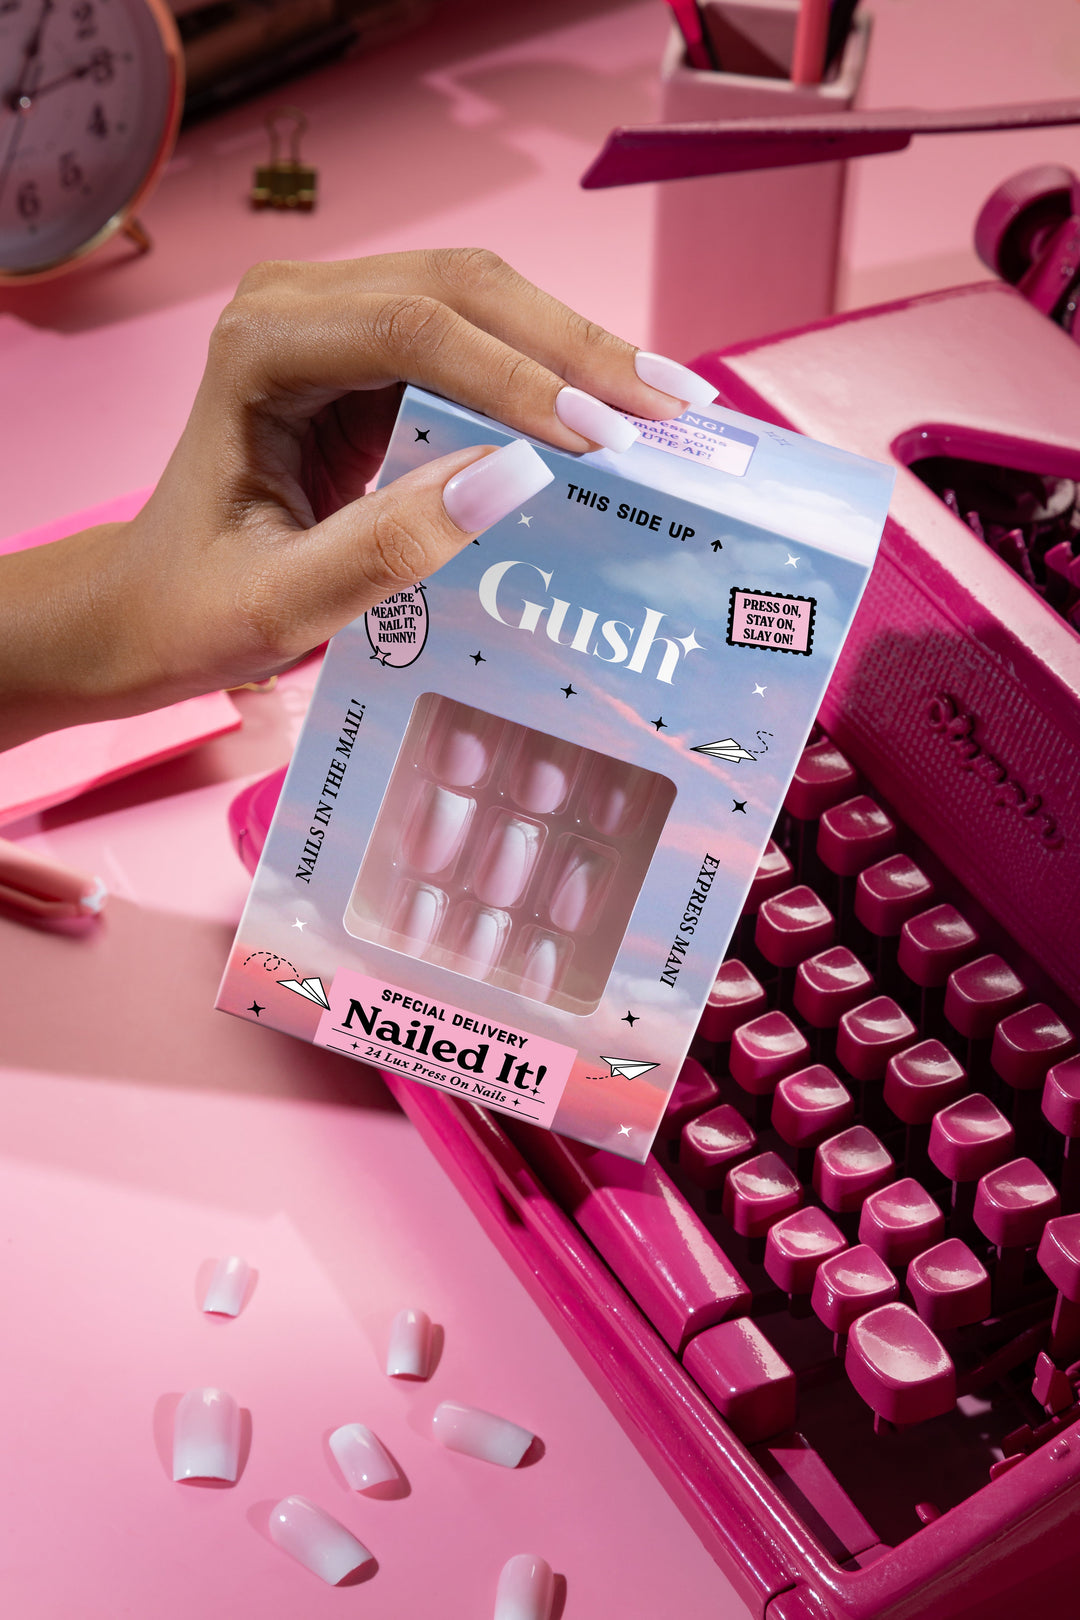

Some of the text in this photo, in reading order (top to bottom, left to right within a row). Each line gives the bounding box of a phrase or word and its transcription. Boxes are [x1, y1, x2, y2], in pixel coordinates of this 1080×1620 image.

[86, 101, 110, 141] 4
[59, 150, 83, 190] 5
[16, 179, 42, 220] 6
[633, 421, 716, 451] make you
[641, 432, 712, 460] UTE AF!
[651, 419, 728, 447] ress Ons
[567, 483, 695, 542] THIS SIDE UP
[371, 604, 422, 619] MEANT TO
[380, 592, 415, 604] OU'RE
[743, 598, 801, 618] PRESS ON,
[378, 631, 416, 644] HUNNY!
[379, 617, 417, 631] NAIL IT,
[478, 560, 681, 686] Gush
[743, 628, 794, 645] SLAY ON!
[746, 613, 796, 632] STAY ON,
[295, 698, 366, 884] NAILS IN THE MAIL!
[659, 852, 721, 989] EXPRESS MANI
[381, 989, 529, 1050] SPECIAL DELIVERY
[341, 998, 548, 1090] Nailed It!
[364, 1046, 507, 1103] 24 Lux Press On Nails
